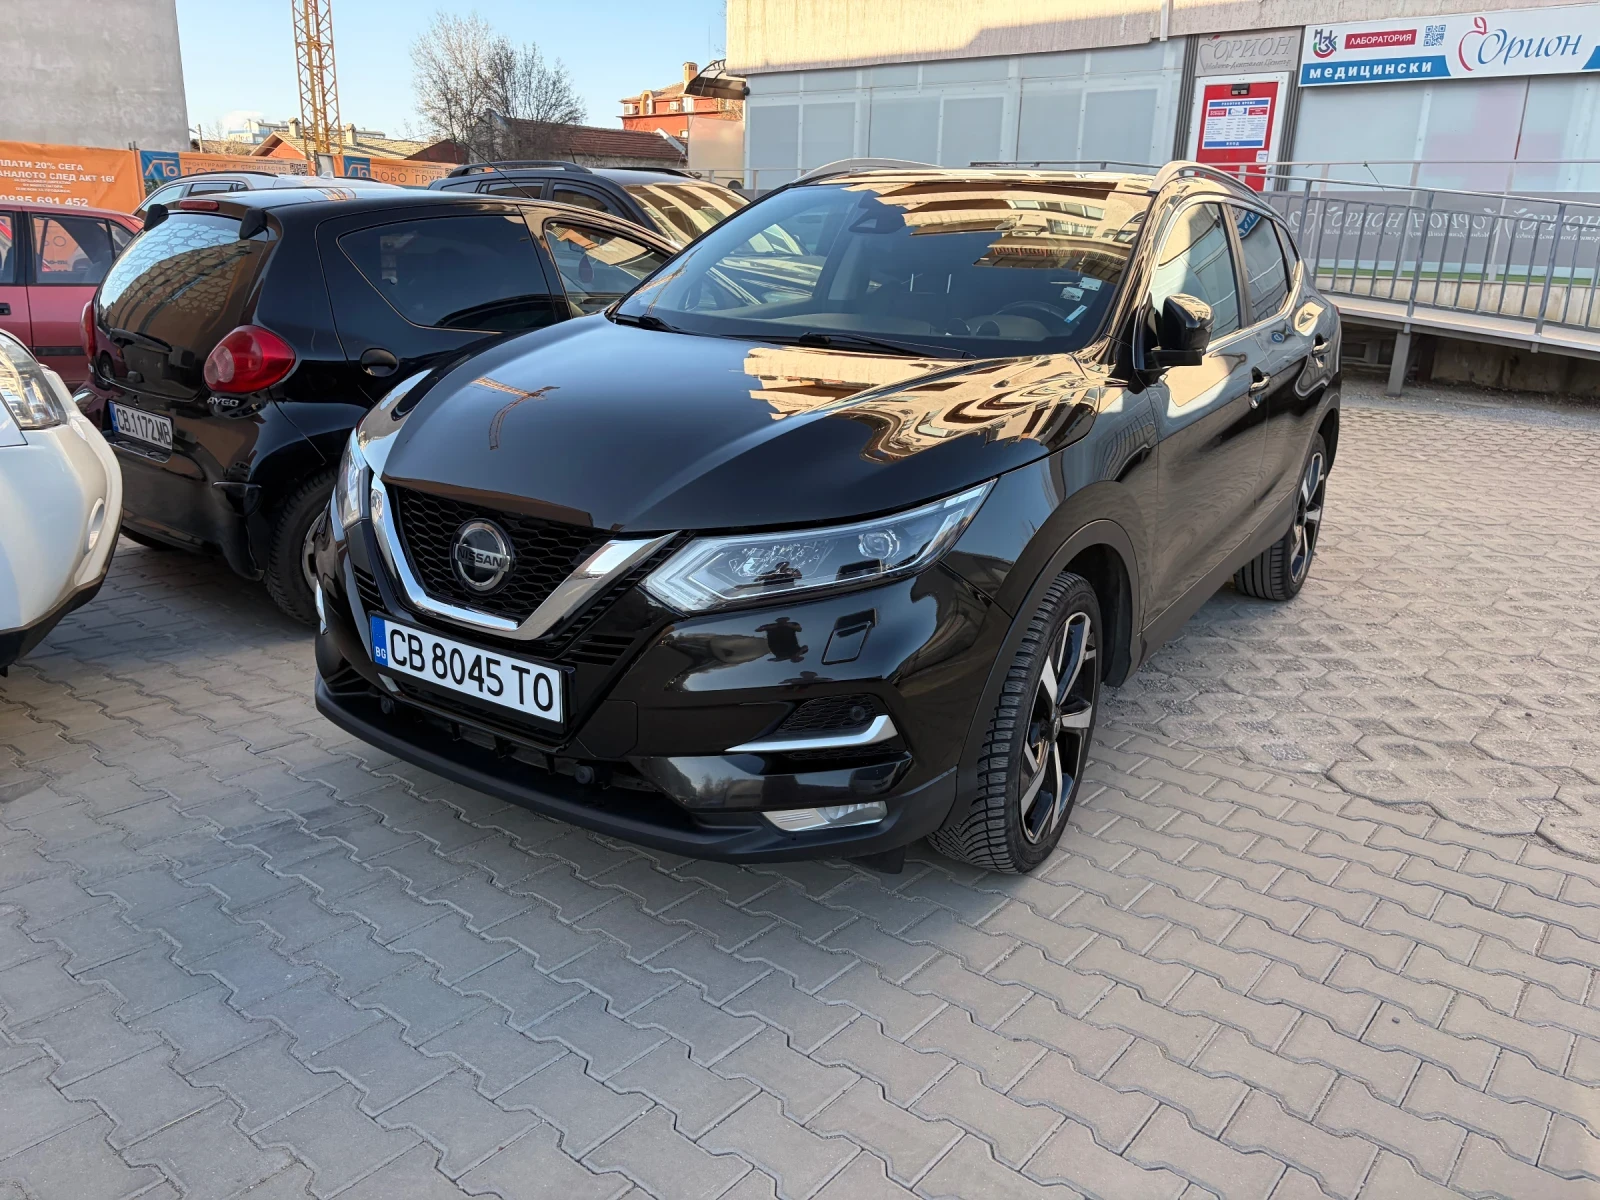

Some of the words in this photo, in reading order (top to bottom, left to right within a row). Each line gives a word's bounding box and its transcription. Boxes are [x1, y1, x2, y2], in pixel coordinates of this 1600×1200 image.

[1349, 33, 1412, 46] ЛАБОРАТОРИЯ
[1213, 36, 1295, 62] ОРИОН
[1477, 28, 1583, 66] Орион
[1309, 61, 1433, 80] медицински
[35, 161, 56, 170] 20%
[57, 163, 84, 171] СЕГА
[49, 172, 77, 181] СЛЕД
[78, 174, 98, 183] АКТ
[99, 175, 115, 183] 16!
[374, 171, 407, 183] ТОБО
[64, 198, 89, 207] 452
[207, 396, 239, 407] AYGO
[460, 550, 502, 567] NISSAN
[375, 646, 387, 660] BG
[389, 628, 426, 672] CB
[431, 642, 504, 697] 8045
[510, 664, 554, 712] TO
